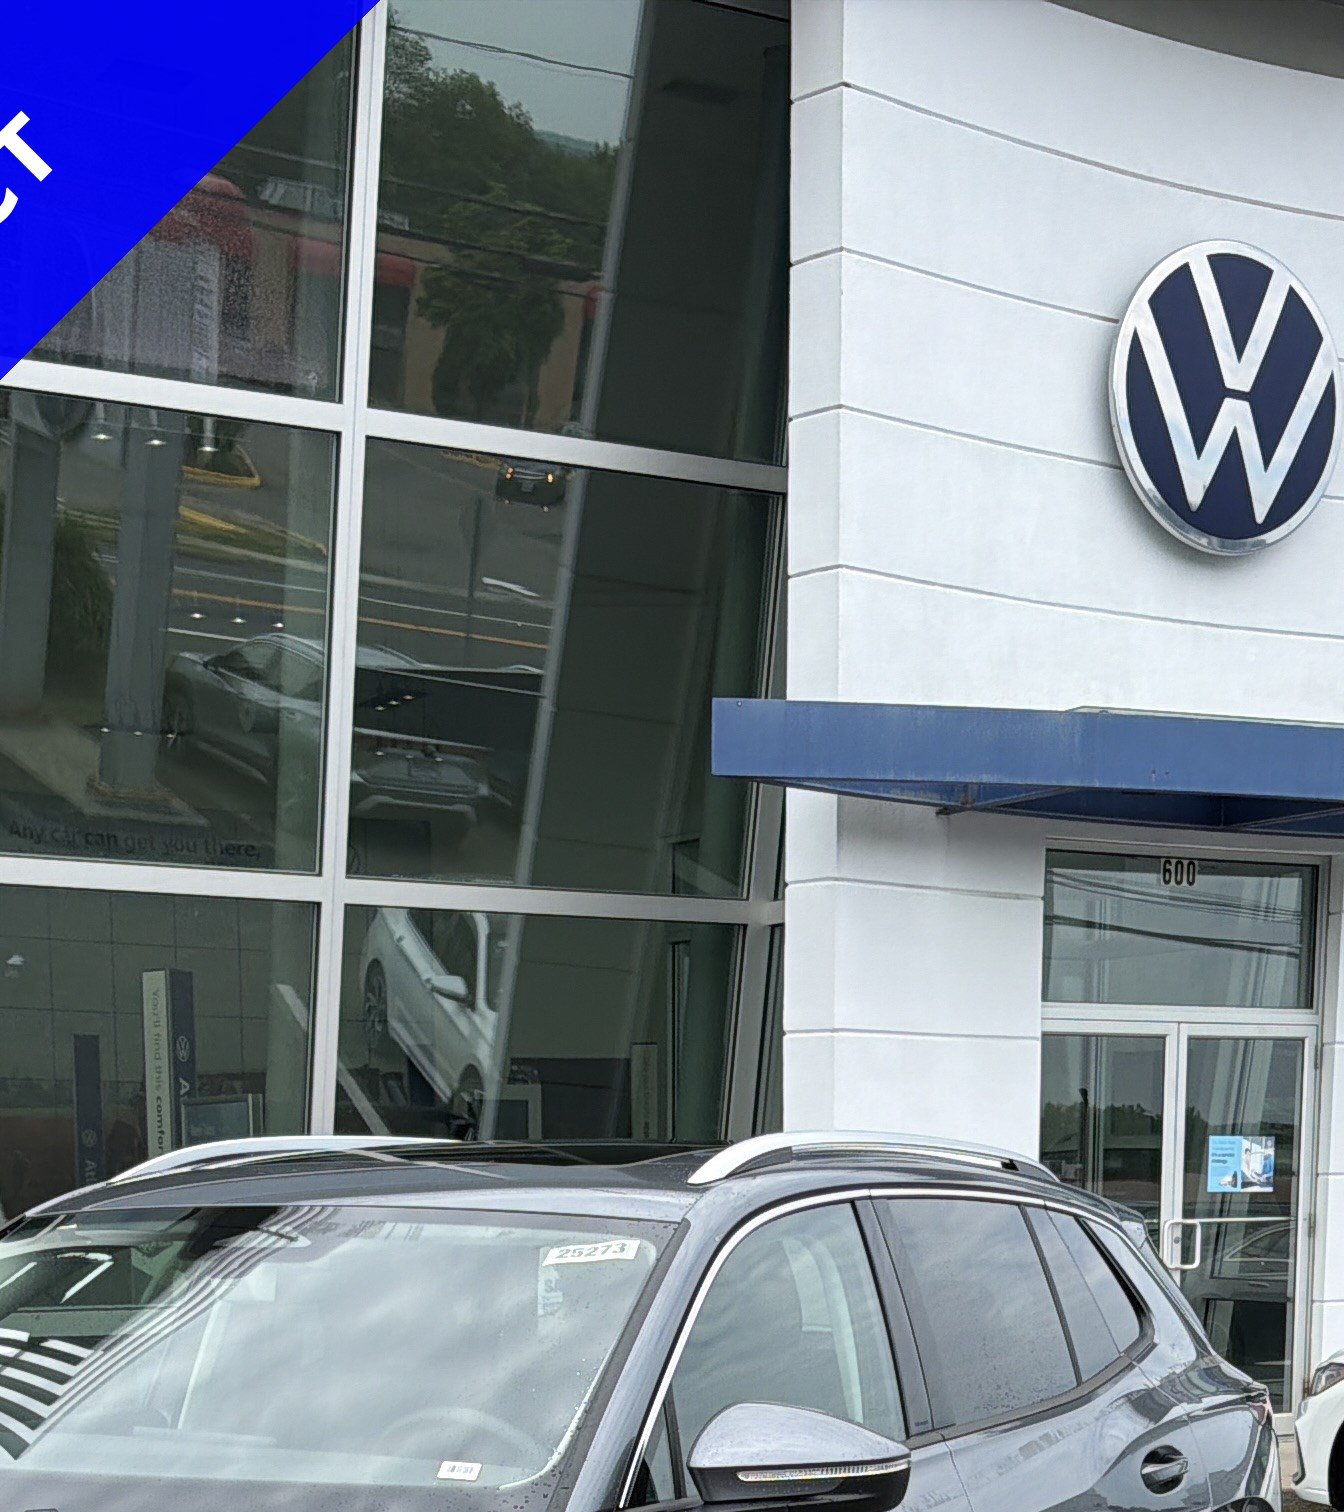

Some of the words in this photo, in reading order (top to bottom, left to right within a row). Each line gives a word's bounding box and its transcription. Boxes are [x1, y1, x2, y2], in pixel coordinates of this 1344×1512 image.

[1162, 859, 1196, 886] 600
[155, 1095, 165, 1155] comfor
[555, 1242, 627, 1259] 25273
